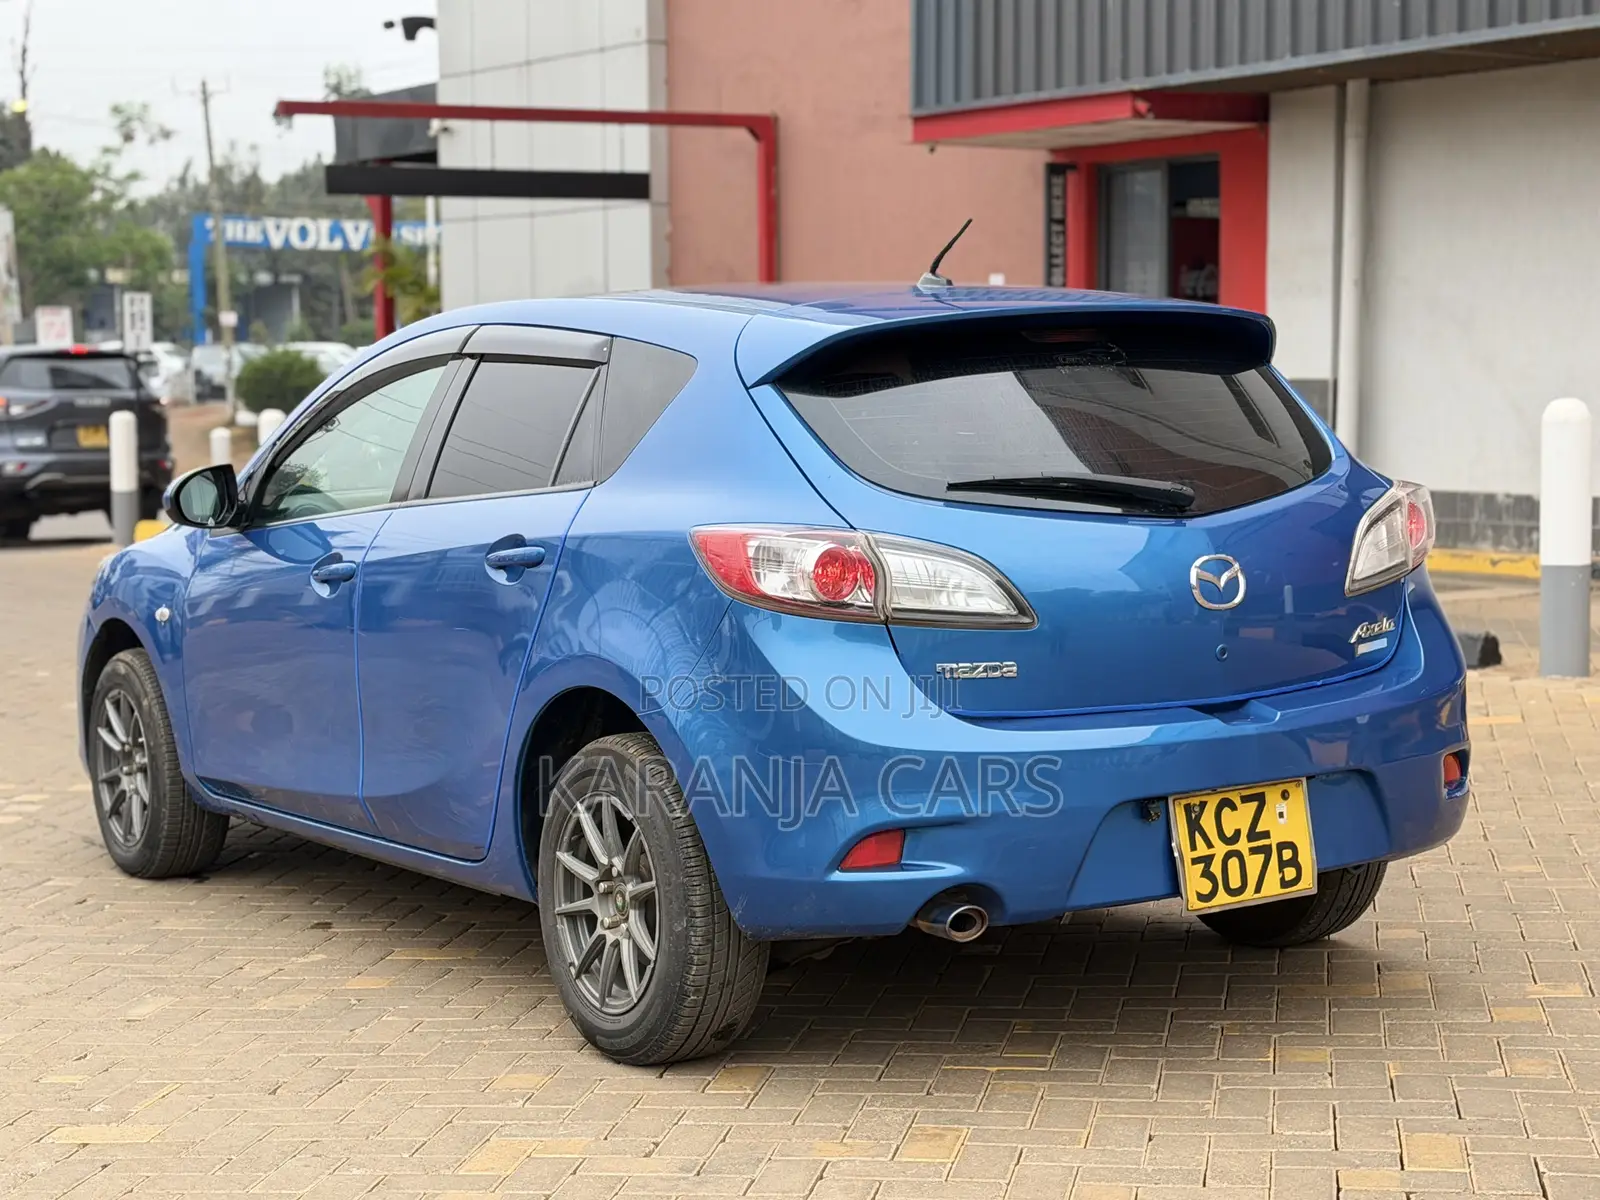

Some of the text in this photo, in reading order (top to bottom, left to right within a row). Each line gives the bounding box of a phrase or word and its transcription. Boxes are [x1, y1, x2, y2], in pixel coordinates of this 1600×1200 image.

[262, 216, 397, 250] VOLV
[1050, 222, 1064, 287] OLLECT
[1348, 616, 1396, 644] Axela
[1183, 791, 1272, 852] KCZ
[1190, 841, 1303, 903] 307B
